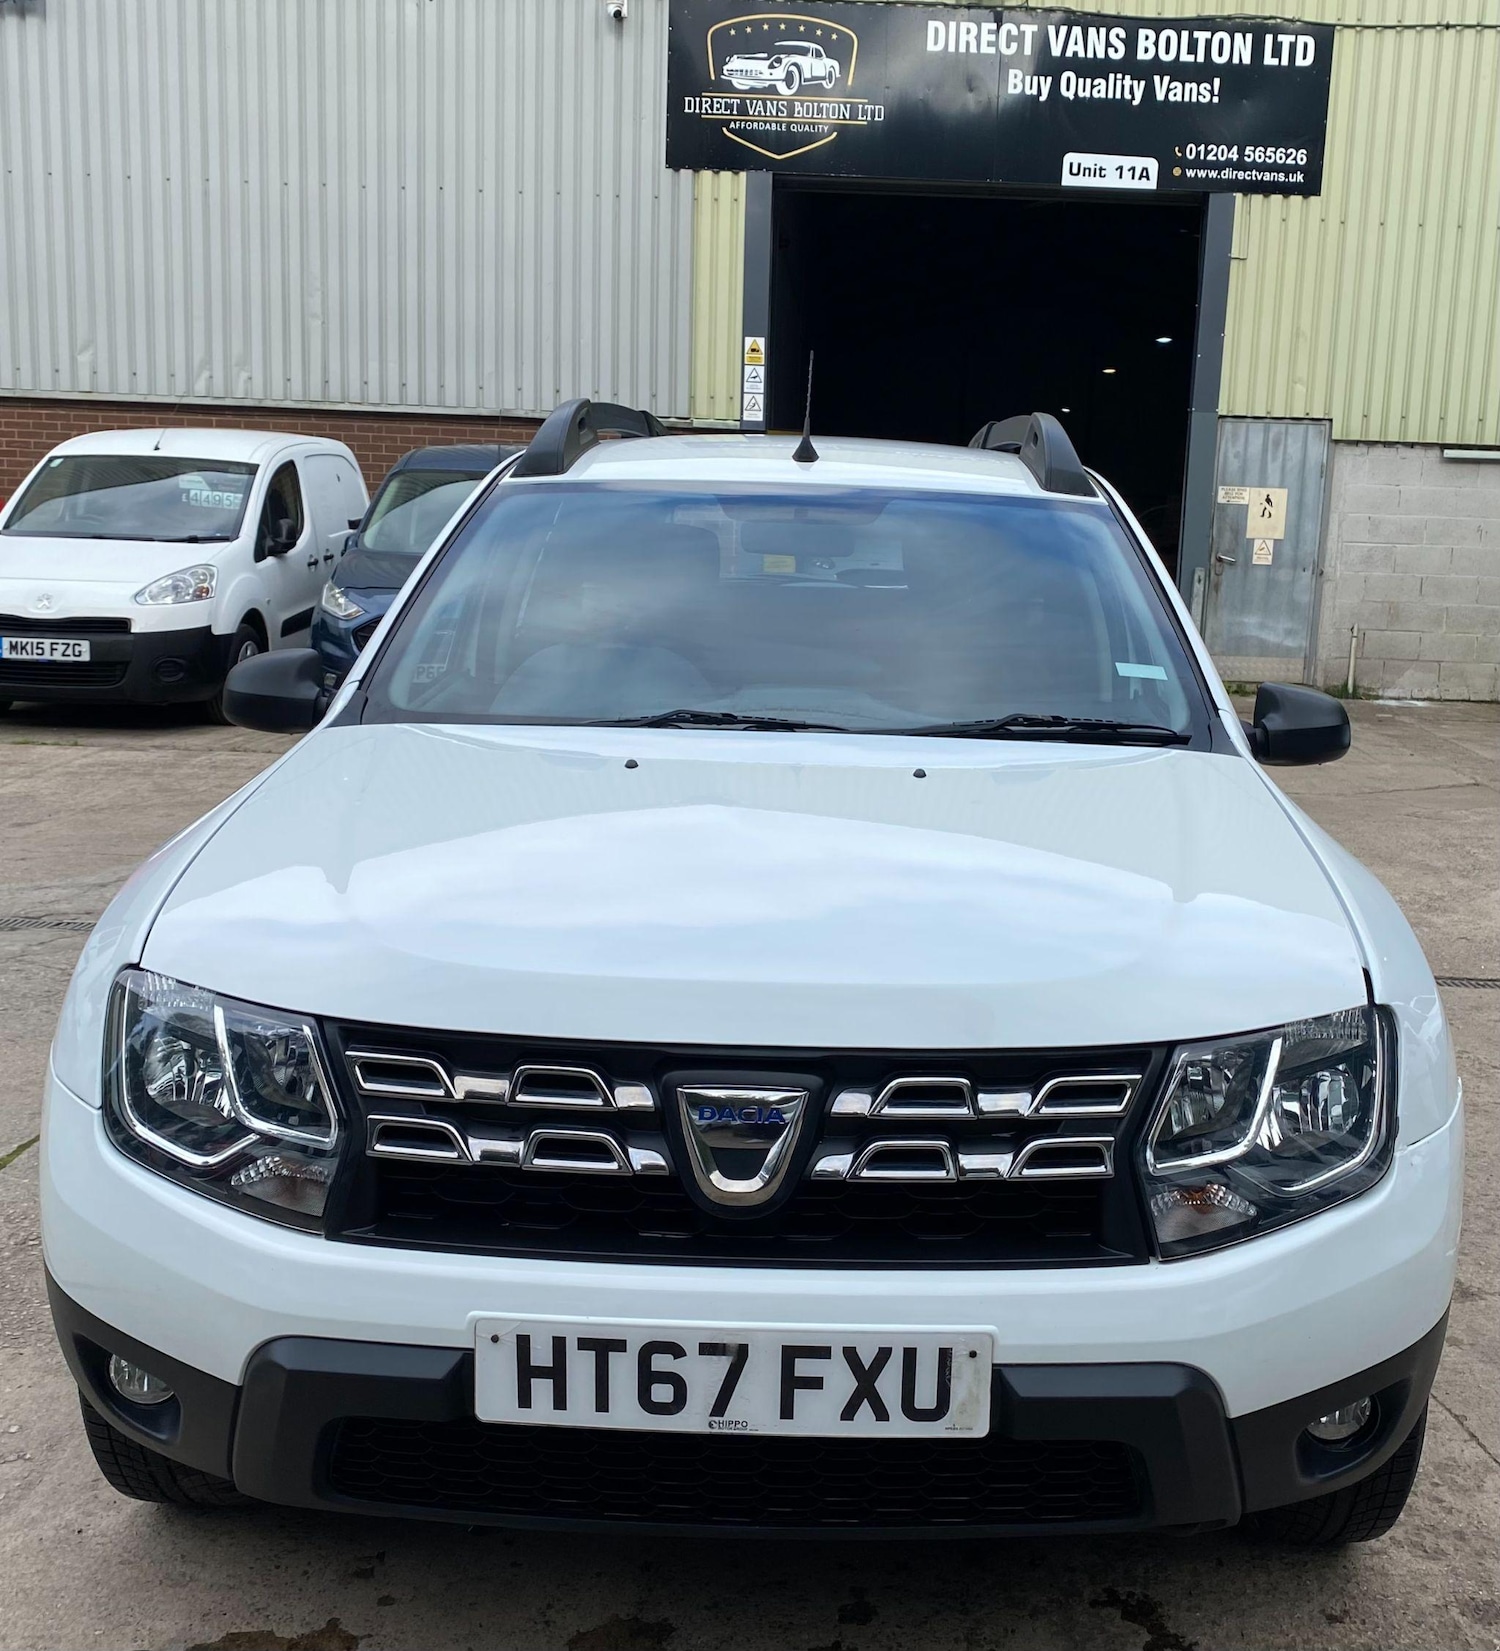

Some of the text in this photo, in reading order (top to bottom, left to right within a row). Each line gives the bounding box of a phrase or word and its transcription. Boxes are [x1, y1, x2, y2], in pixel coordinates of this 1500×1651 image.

[926, 20, 1316, 67] DIRECT VANS BOLTON LTD
[1007, 69, 1221, 106] Buy Quality Vans!
[684, 96, 885, 121] DIRECT VANS BOLTON LTD
[729, 120, 829, 134] AFFORDABLE QUALITY
[1185, 143, 1308, 166] 01204 565626
[1068, 161, 1151, 182] Unit 11A
[1185, 166, 1305, 183] www.directvans.uk
[9, 640, 82, 658] MK15 FZG
[697, 1105, 788, 1125] DACIA
[516, 1333, 954, 1423] HT67 FXU
[718, 1419, 749, 1428] HIPPO
